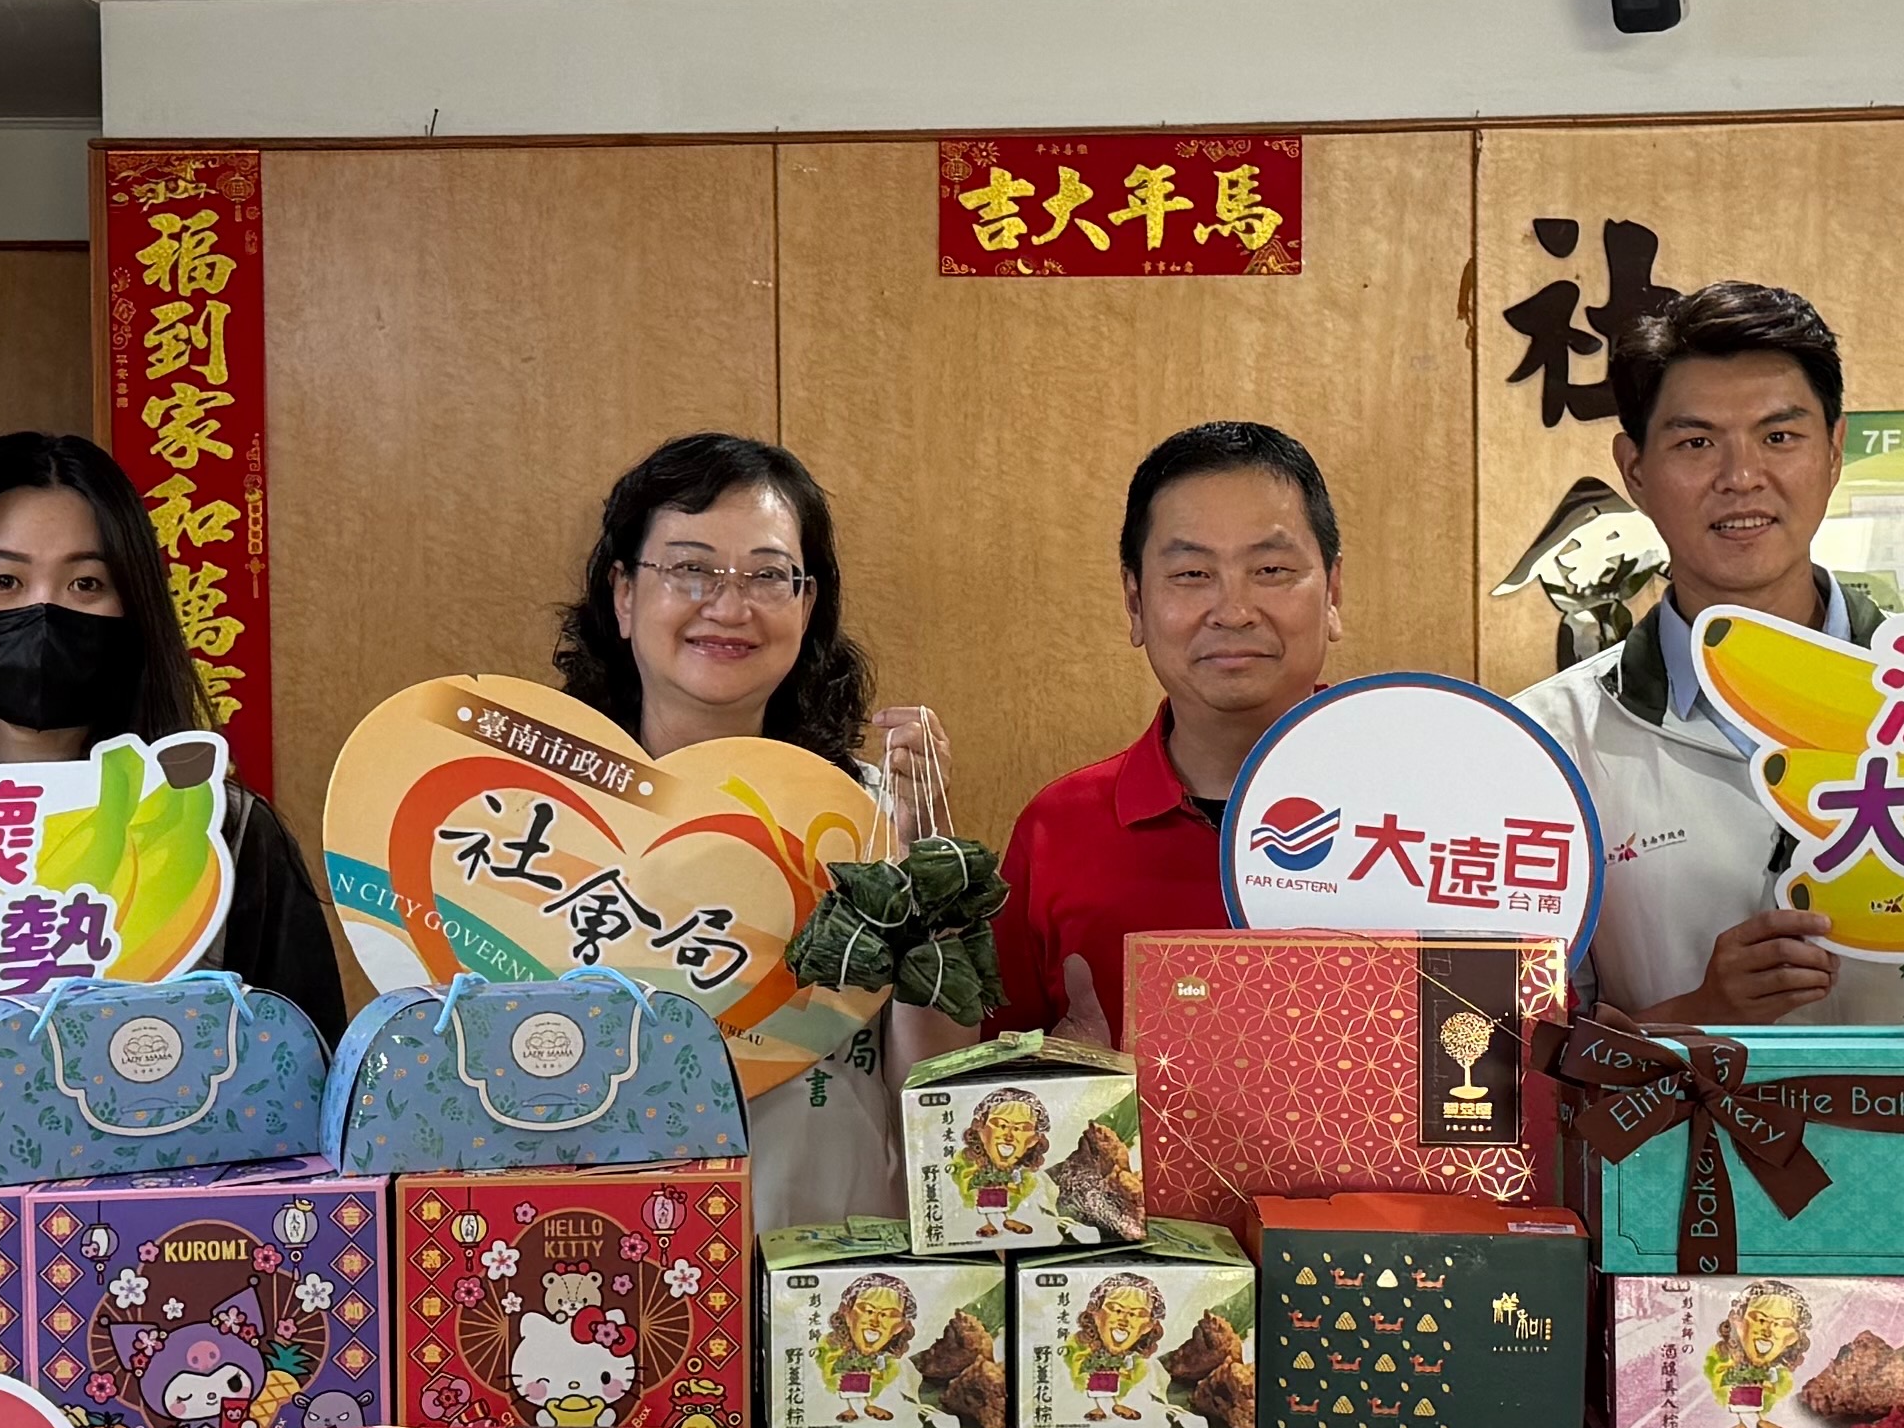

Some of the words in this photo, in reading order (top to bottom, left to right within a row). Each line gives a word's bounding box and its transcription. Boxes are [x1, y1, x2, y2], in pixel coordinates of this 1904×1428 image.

[1862, 429, 1902, 454] 7F
[475, 707, 637, 794] 臺南市政府
[1245, 875, 1274, 889] FAR
[1276, 878, 1338, 895] EASTERN
[1348, 813, 1575, 910] 大遠百
[359, 881, 422, 920] CITY
[439, 794, 751, 990] 社會局
[1507, 892, 1562, 915] 台南
[1177, 983, 1206, 996] idol
[845, 1028, 876, 1075] 局
[805, 1067, 832, 1107] 書
[1610, 1076, 1678, 1131] Elite
[1758, 1085, 1833, 1114] Elite
[941, 1110, 957, 1174] 彭老師の
[921, 1164, 944, 1241] 野薑花粽
[163, 1239, 250, 1264] KUROMI
[544, 1218, 604, 1239] HELLO
[544, 1239, 604, 1259] KITTY
[808, 1293, 822, 1357] 彭老師の
[1056, 1291, 1071, 1356] 彭老師の
[1493, 1292, 1543, 1340] 祥和
[1681, 1296, 1694, 1354] 彭老師の
[785, 1346, 805, 1425] 野薑花粽
[1033, 1345, 1053, 1423] 野薑花粽
[631, 1406, 652, 1428] Box
